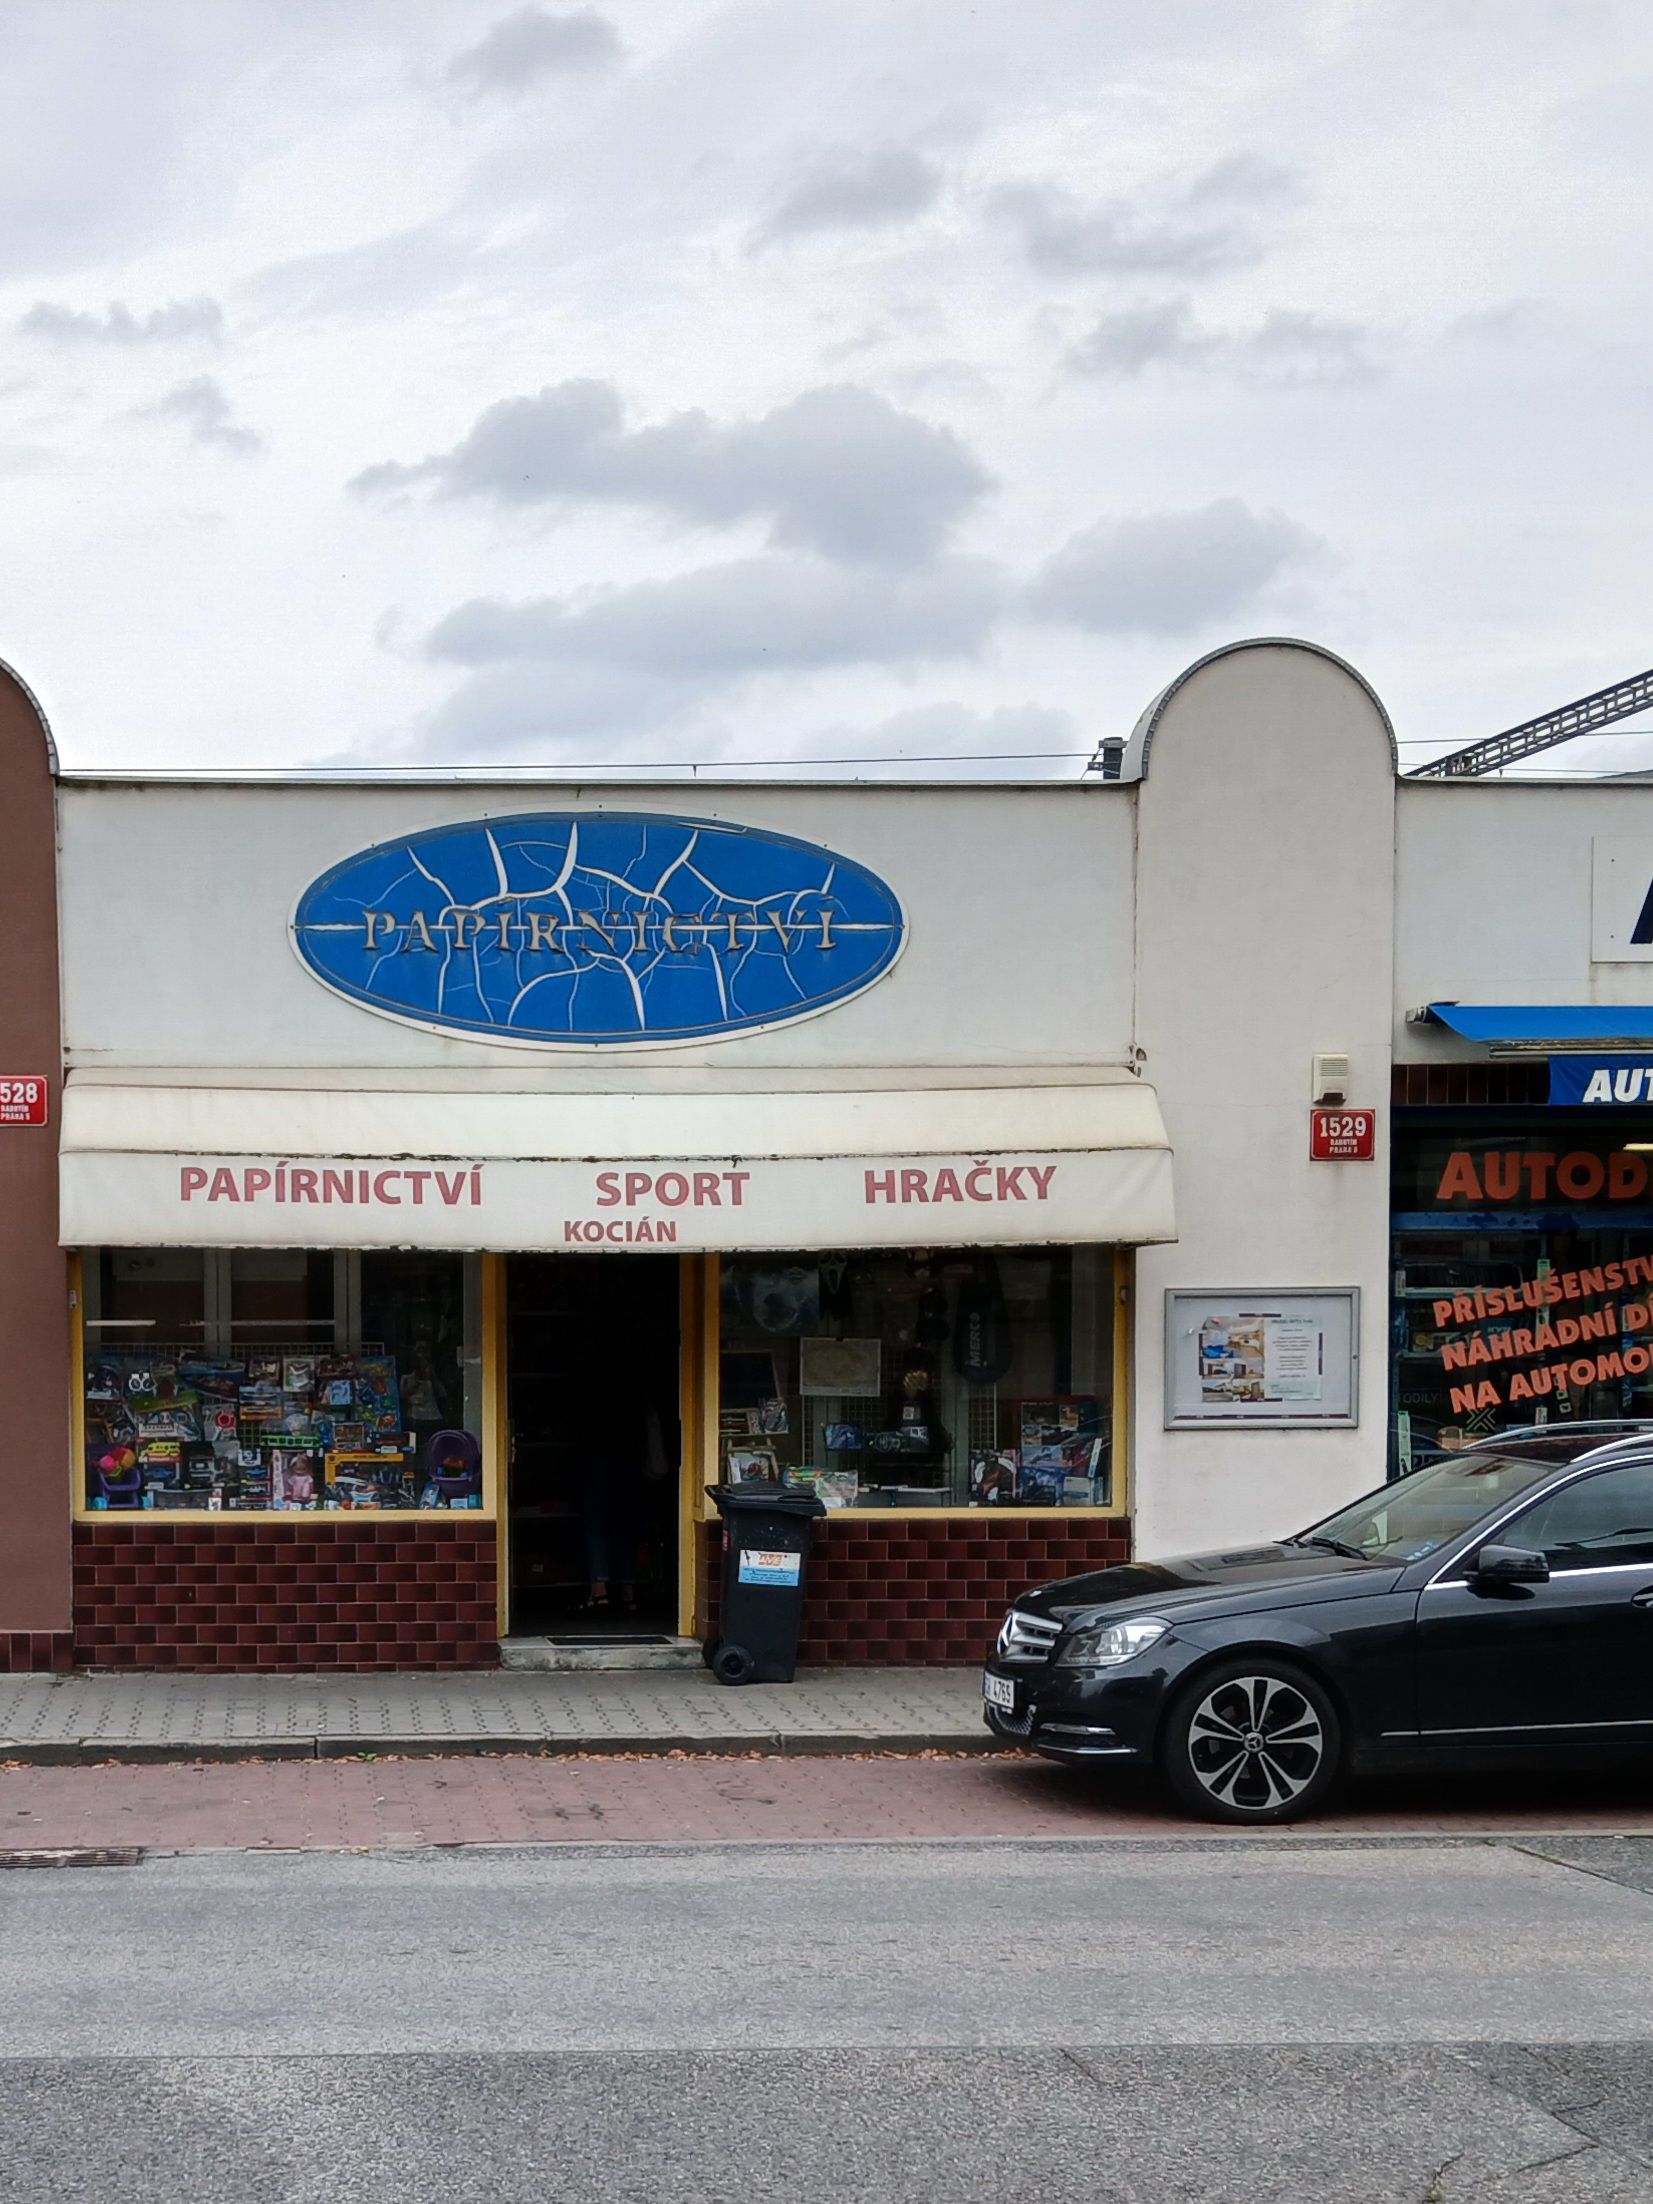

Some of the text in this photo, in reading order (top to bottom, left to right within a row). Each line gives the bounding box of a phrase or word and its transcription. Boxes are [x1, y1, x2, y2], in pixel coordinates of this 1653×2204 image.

[1320, 1117, 1366, 1137] 1529
[182, 1160, 1057, 1207] PAPÍRNICTVÍ SPORT HRAČKY
[1436, 1152, 1653, 1200] AUTOD
[564, 1216, 677, 1243] KOCIÁN
[1441, 1301, 1617, 1371] NÁHRADNÍ
[1450, 1380, 1501, 1414] NA
[1509, 1344, 1653, 1401] AUTOMO
